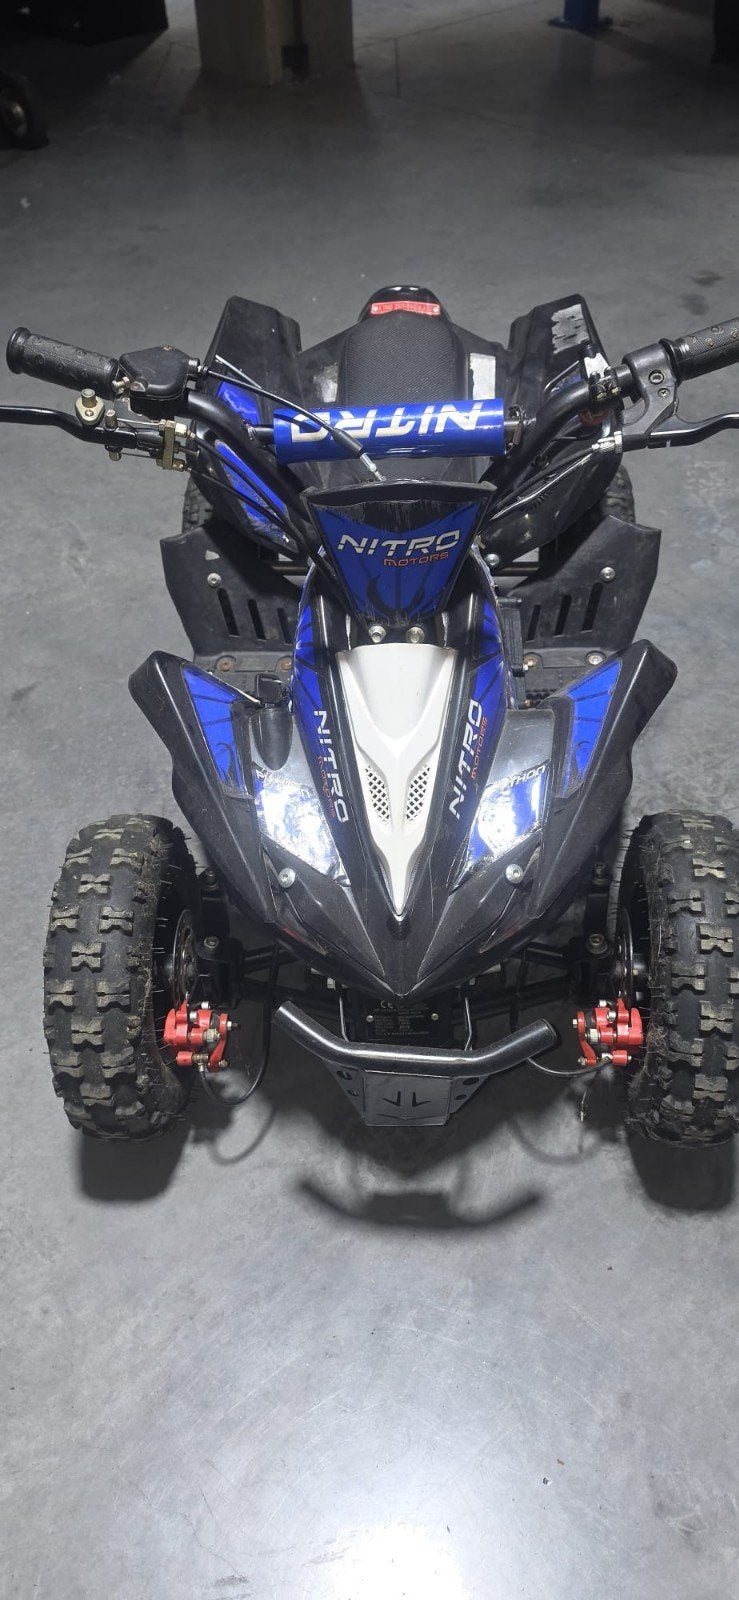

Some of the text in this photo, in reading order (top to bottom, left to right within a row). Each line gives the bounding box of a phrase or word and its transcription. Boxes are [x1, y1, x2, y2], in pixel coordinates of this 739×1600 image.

[291, 402, 483, 443] NITRO
[337, 529, 460, 557] NITRO
[383, 551, 449, 567] MOTORS
[314, 710, 349, 823] NITRO
[449, 698, 482, 820] NITRO
[471, 716, 488, 779] MOTORS
